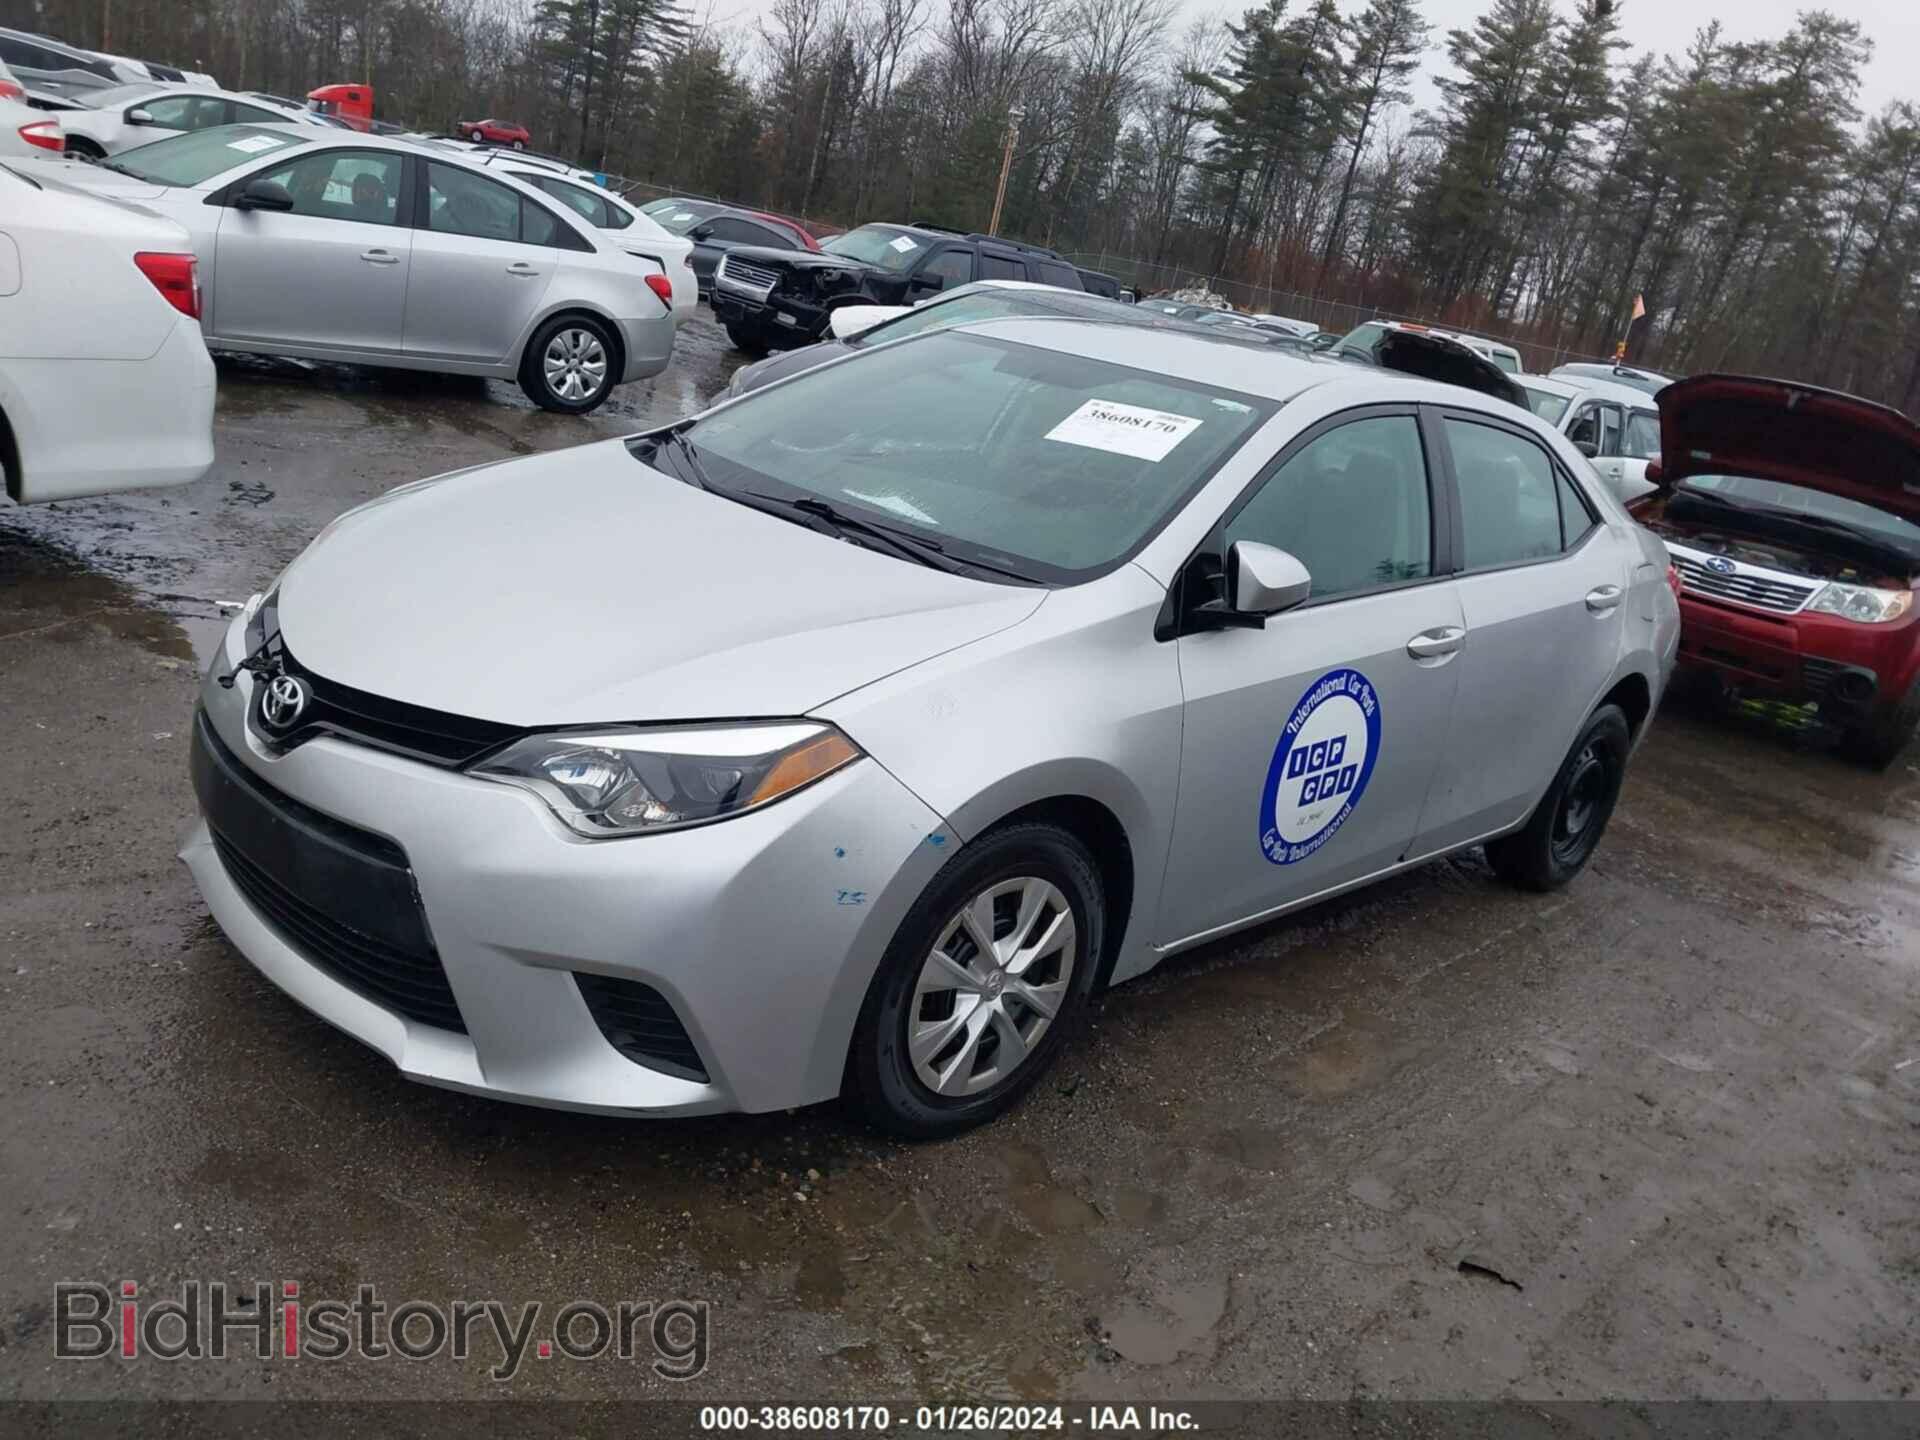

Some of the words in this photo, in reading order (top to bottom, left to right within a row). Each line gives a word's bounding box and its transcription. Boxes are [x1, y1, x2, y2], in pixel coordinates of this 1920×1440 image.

[1090, 409, 1177, 433] 38608170
[1286, 672, 1347, 734] International
[1348, 673, 1362, 695] Car
[1293, 741, 1344, 773] ICP
[1303, 770, 1352, 801] CPI
